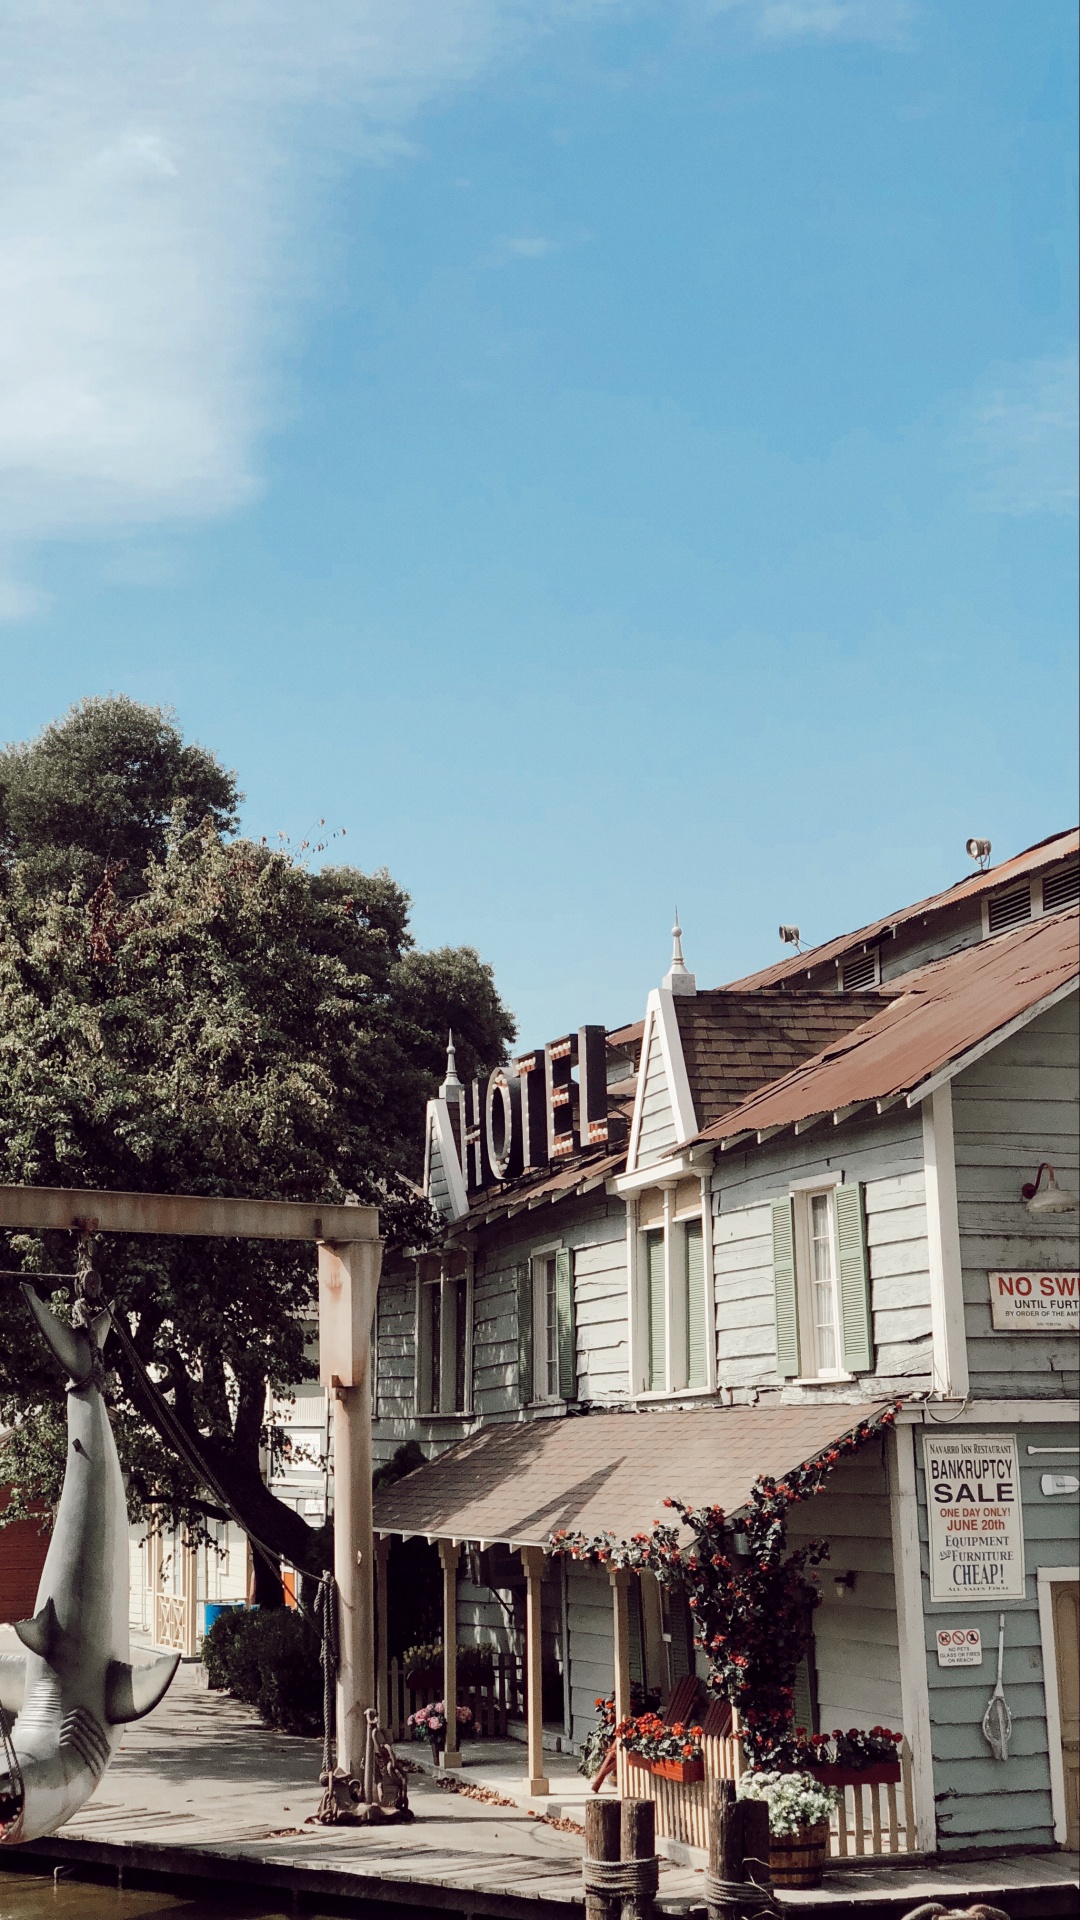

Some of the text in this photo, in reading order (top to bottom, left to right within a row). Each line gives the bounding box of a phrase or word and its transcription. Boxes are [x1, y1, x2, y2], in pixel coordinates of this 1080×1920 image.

[459, 1025, 622, 1192] HOTEL
[998, 1276, 1032, 1296] NO
[1014, 1299, 1079, 1309] UNTIL FURT
[931, 1459, 1012, 1479] BANKRUPTCY
[934, 1483, 1015, 1503] SALE
[940, 1507, 1011, 1518] ONE DAY ONLY!
[947, 1519, 1006, 1531] JUNE 20th
[952, 1563, 1004, 1586] CHEAP!
